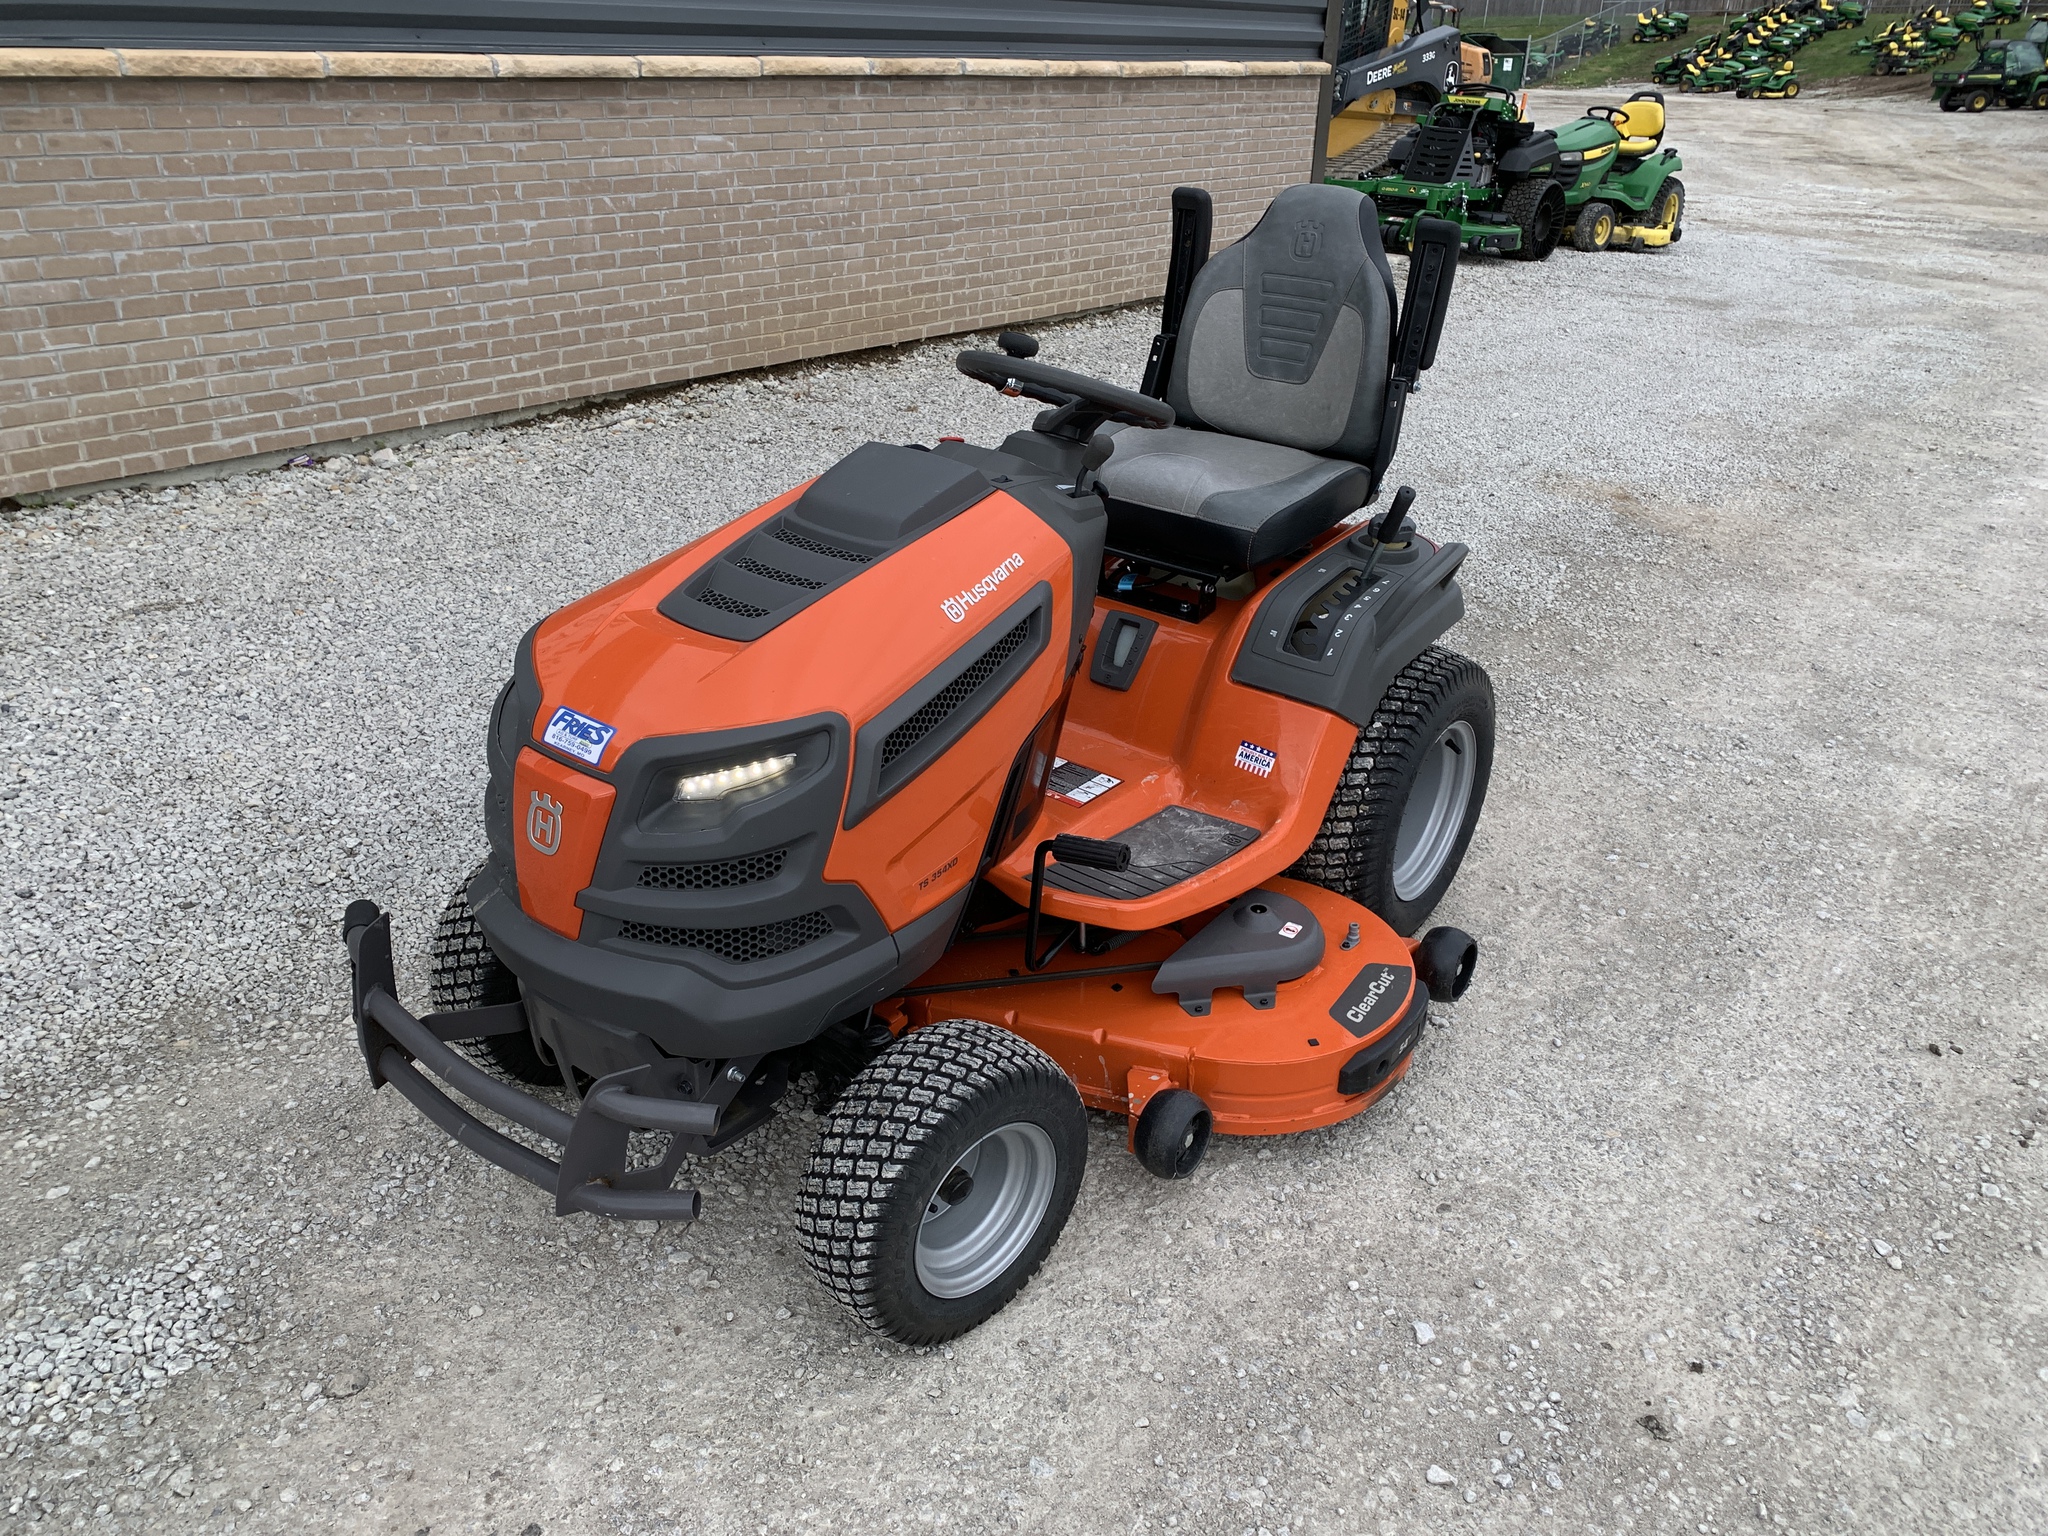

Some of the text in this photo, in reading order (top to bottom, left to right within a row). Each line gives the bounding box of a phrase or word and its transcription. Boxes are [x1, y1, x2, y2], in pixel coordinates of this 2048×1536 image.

[1366, 65, 1393, 85] DEERE
[955, 551, 1025, 611] Husqvarna
[1344, 613, 1353, 621] 3
[1334, 629, 1343, 637] 2
[1326, 648, 1333, 657] 1
[551, 710, 611, 745] FRIES
[1239, 751, 1270, 768] AMERICA
[918, 856, 959, 890] TS 354XD
